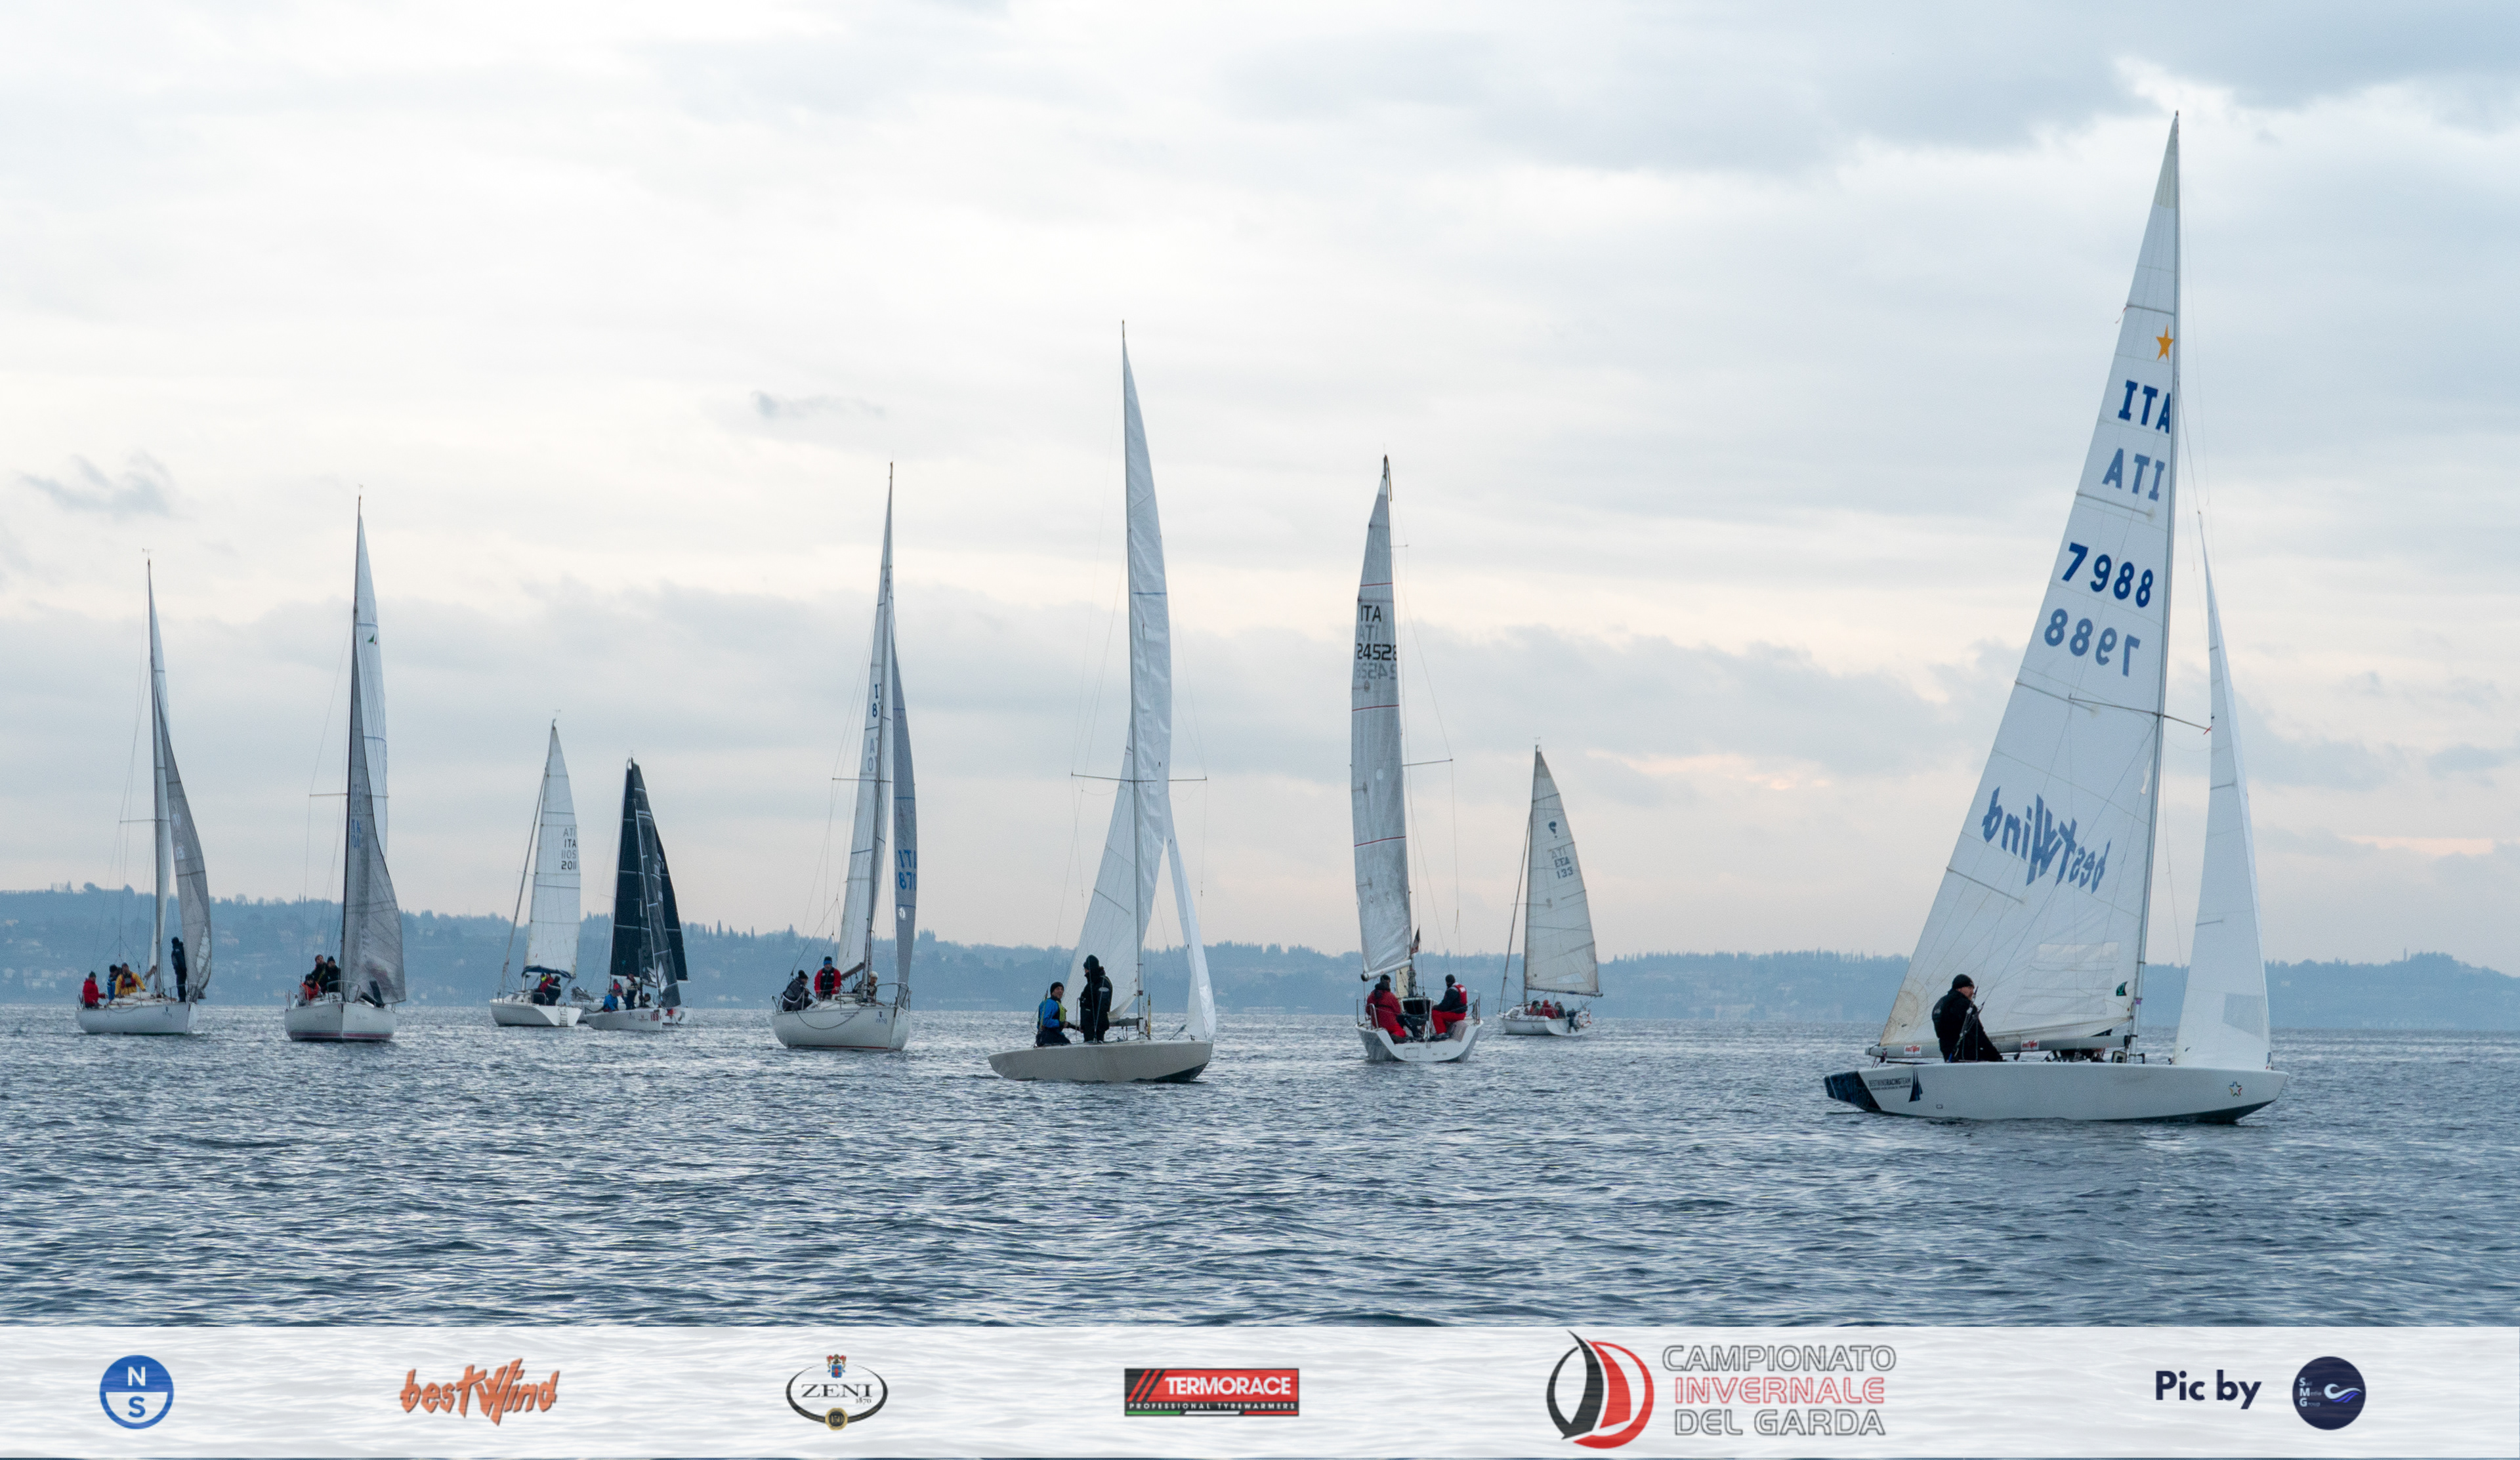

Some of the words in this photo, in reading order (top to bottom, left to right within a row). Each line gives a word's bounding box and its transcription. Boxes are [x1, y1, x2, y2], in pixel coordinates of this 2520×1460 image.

[2118, 379, 2171, 434] ITA
[2061, 542, 2153, 608] 7988
[1360, 604, 1381, 622] ITA
[564, 839, 577, 848] ITA
[1557, 866, 1574, 879] 133
